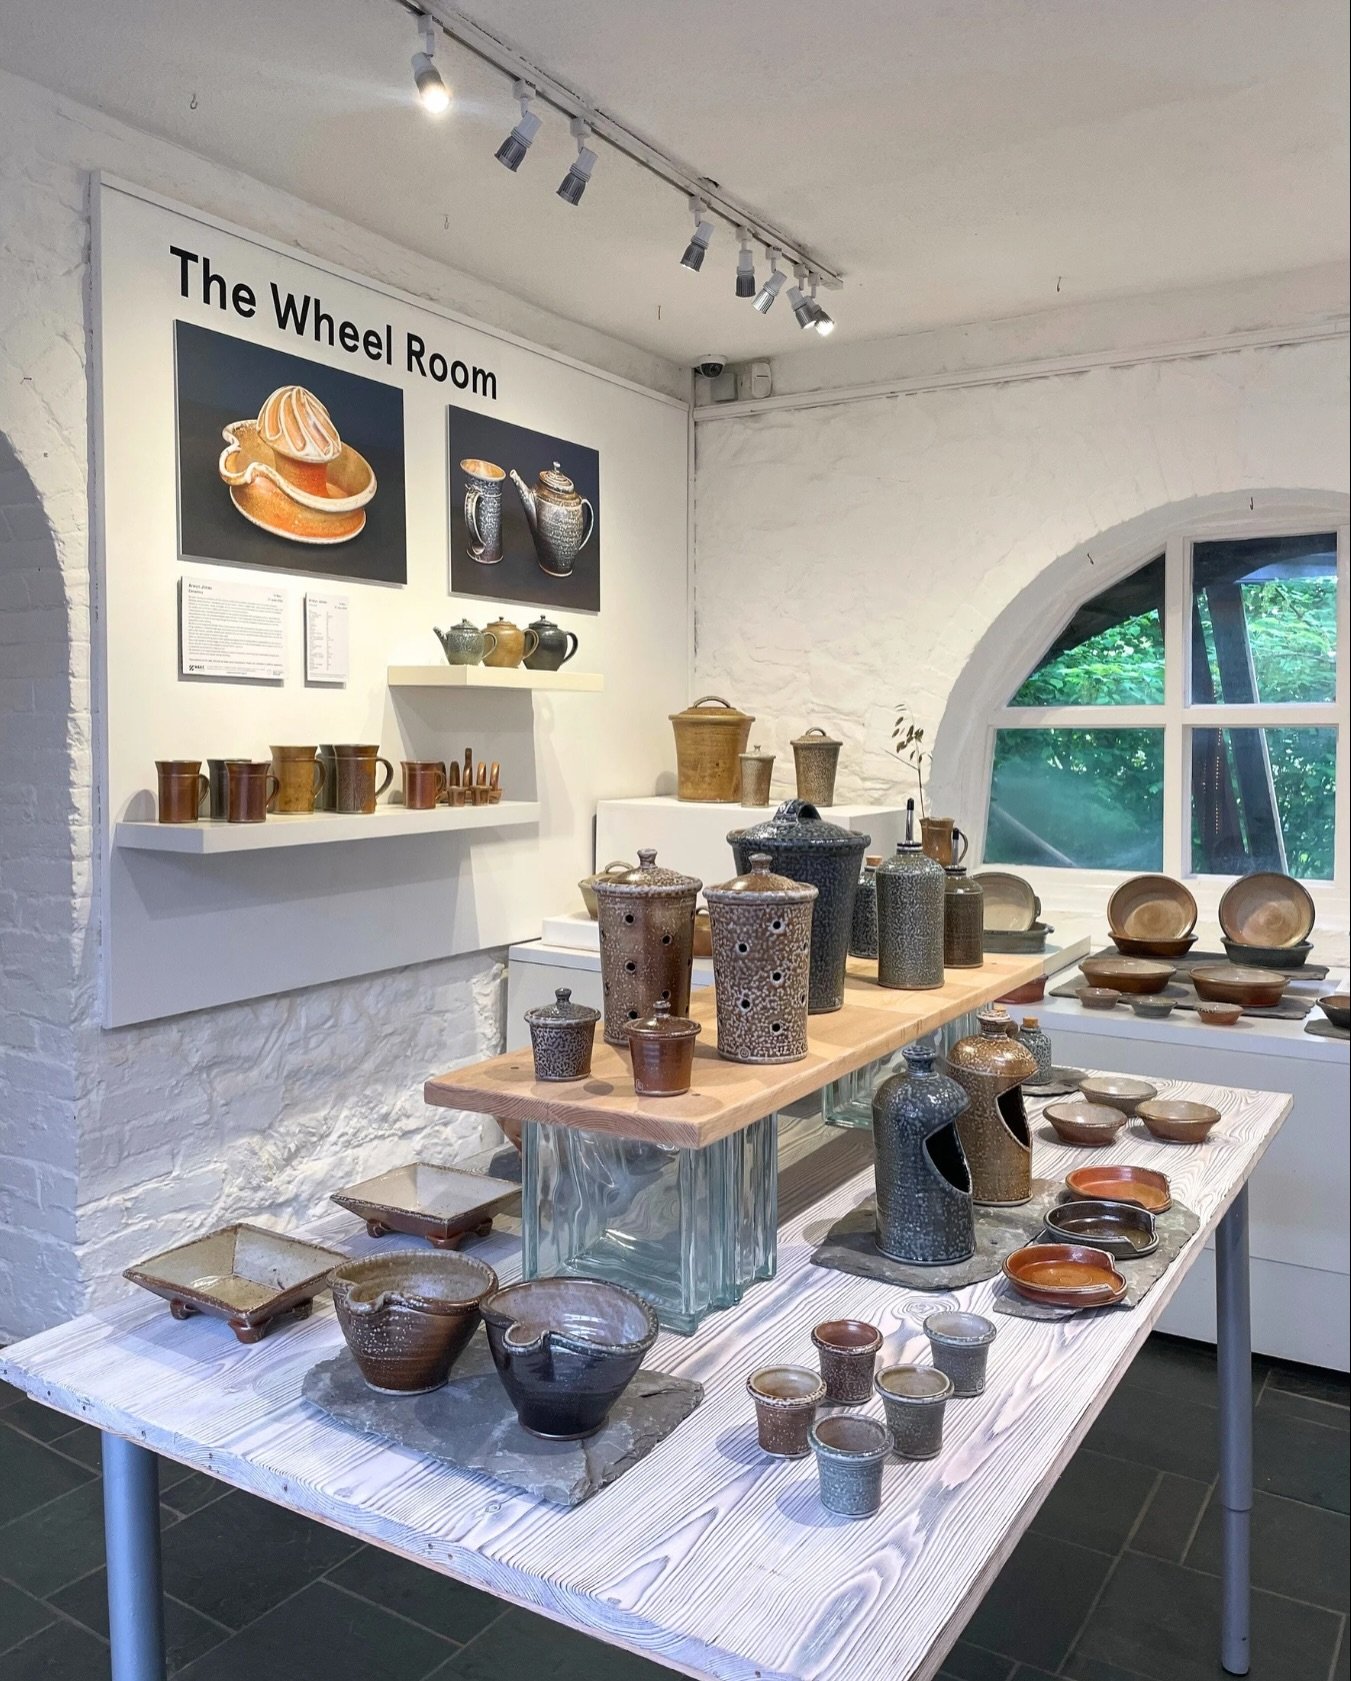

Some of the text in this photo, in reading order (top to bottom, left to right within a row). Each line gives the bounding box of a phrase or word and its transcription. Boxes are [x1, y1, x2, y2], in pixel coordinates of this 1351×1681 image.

[170, 246, 497, 399] The Wheel Room
